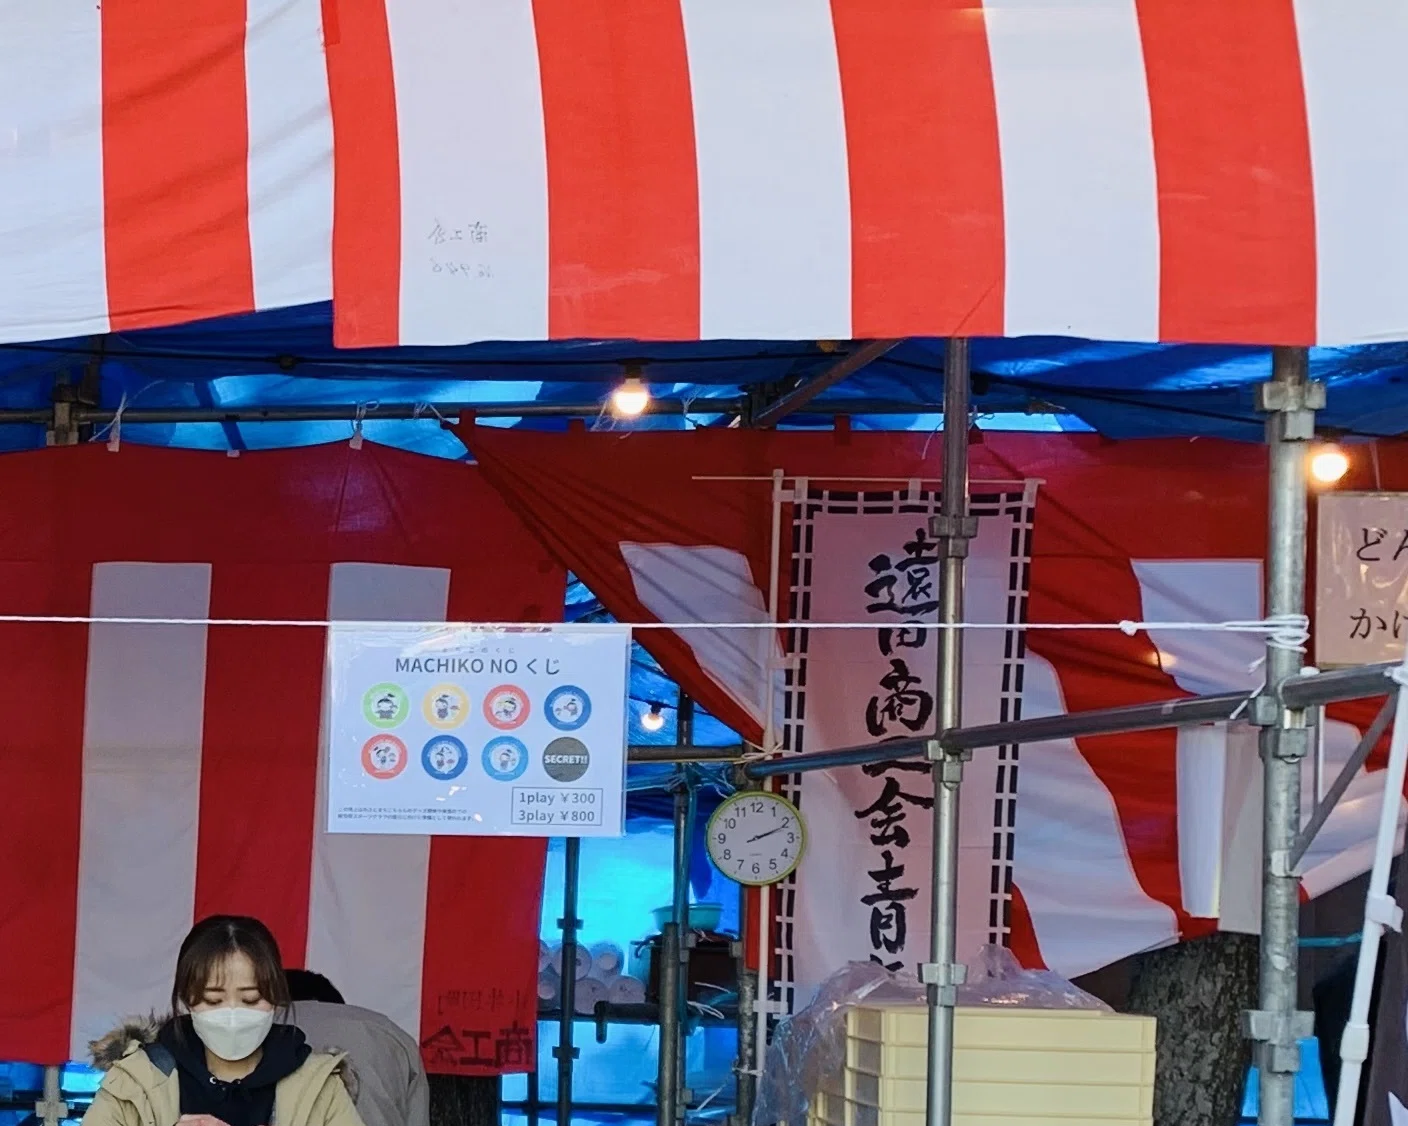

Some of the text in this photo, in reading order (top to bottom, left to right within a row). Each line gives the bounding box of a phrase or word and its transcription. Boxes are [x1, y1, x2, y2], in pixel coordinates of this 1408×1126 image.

[395, 657, 560, 675] MACHIKO NO くじ
[855, 527, 940, 973] 遠田商工会青
[519, 792, 555, 806] 1play
[735, 807, 746, 817] 11
[750, 802, 764, 813] 12
[519, 810, 555, 824] 3play
[782, 817, 790, 828] 2
[724, 818, 736, 829] 10
[718, 833, 726, 844] 9
[787, 833, 794, 844] 3
[723, 849, 731, 860] 8
[781, 848, 788, 858] 4
[737, 860, 744, 870] 7
[752, 863, 760, 874] 6
[769, 858, 777, 870] 5
